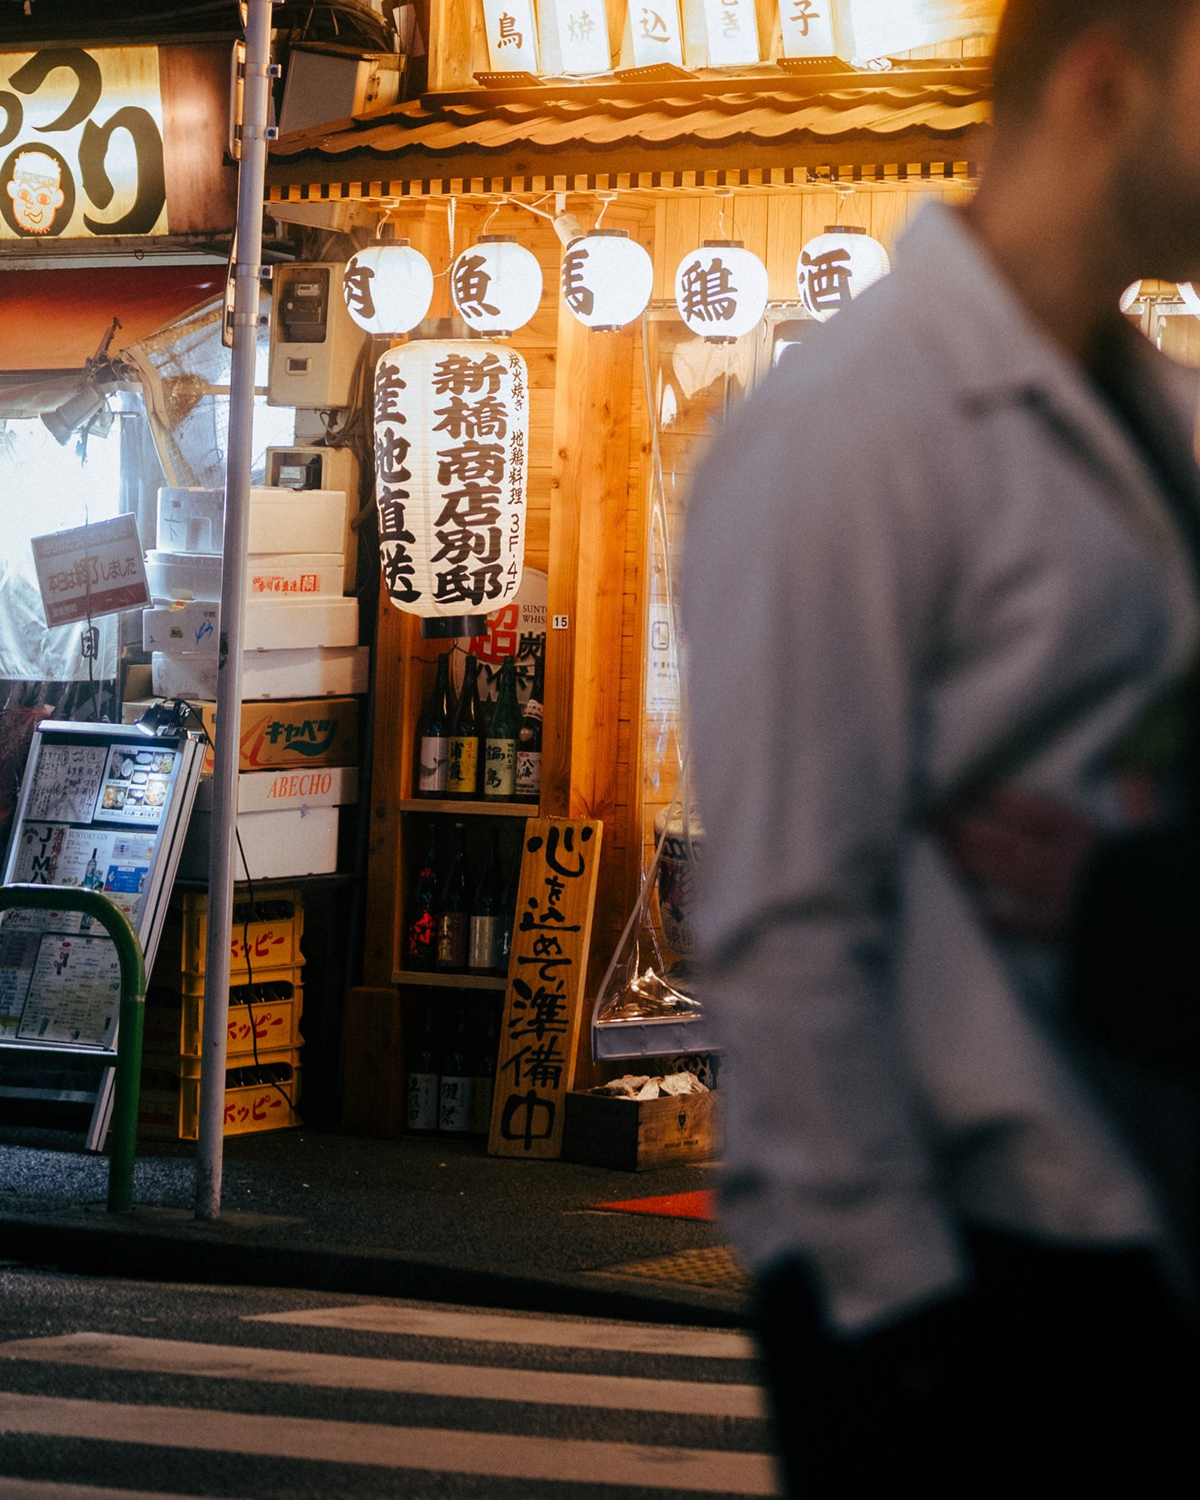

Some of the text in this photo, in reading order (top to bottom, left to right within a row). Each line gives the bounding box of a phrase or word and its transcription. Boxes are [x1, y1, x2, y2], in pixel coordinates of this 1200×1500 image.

[453, 254, 501, 319] 魚
[798, 247, 854, 313] 酒
[373, 361, 422, 603] 産地直送
[430, 351, 509, 606] 新橋商店別邸
[523, 604, 548, 614] SUNT
[554, 616, 568, 628] 15
[517, 631, 546, 661] 炭
[267, 772, 333, 799] ABECHO
